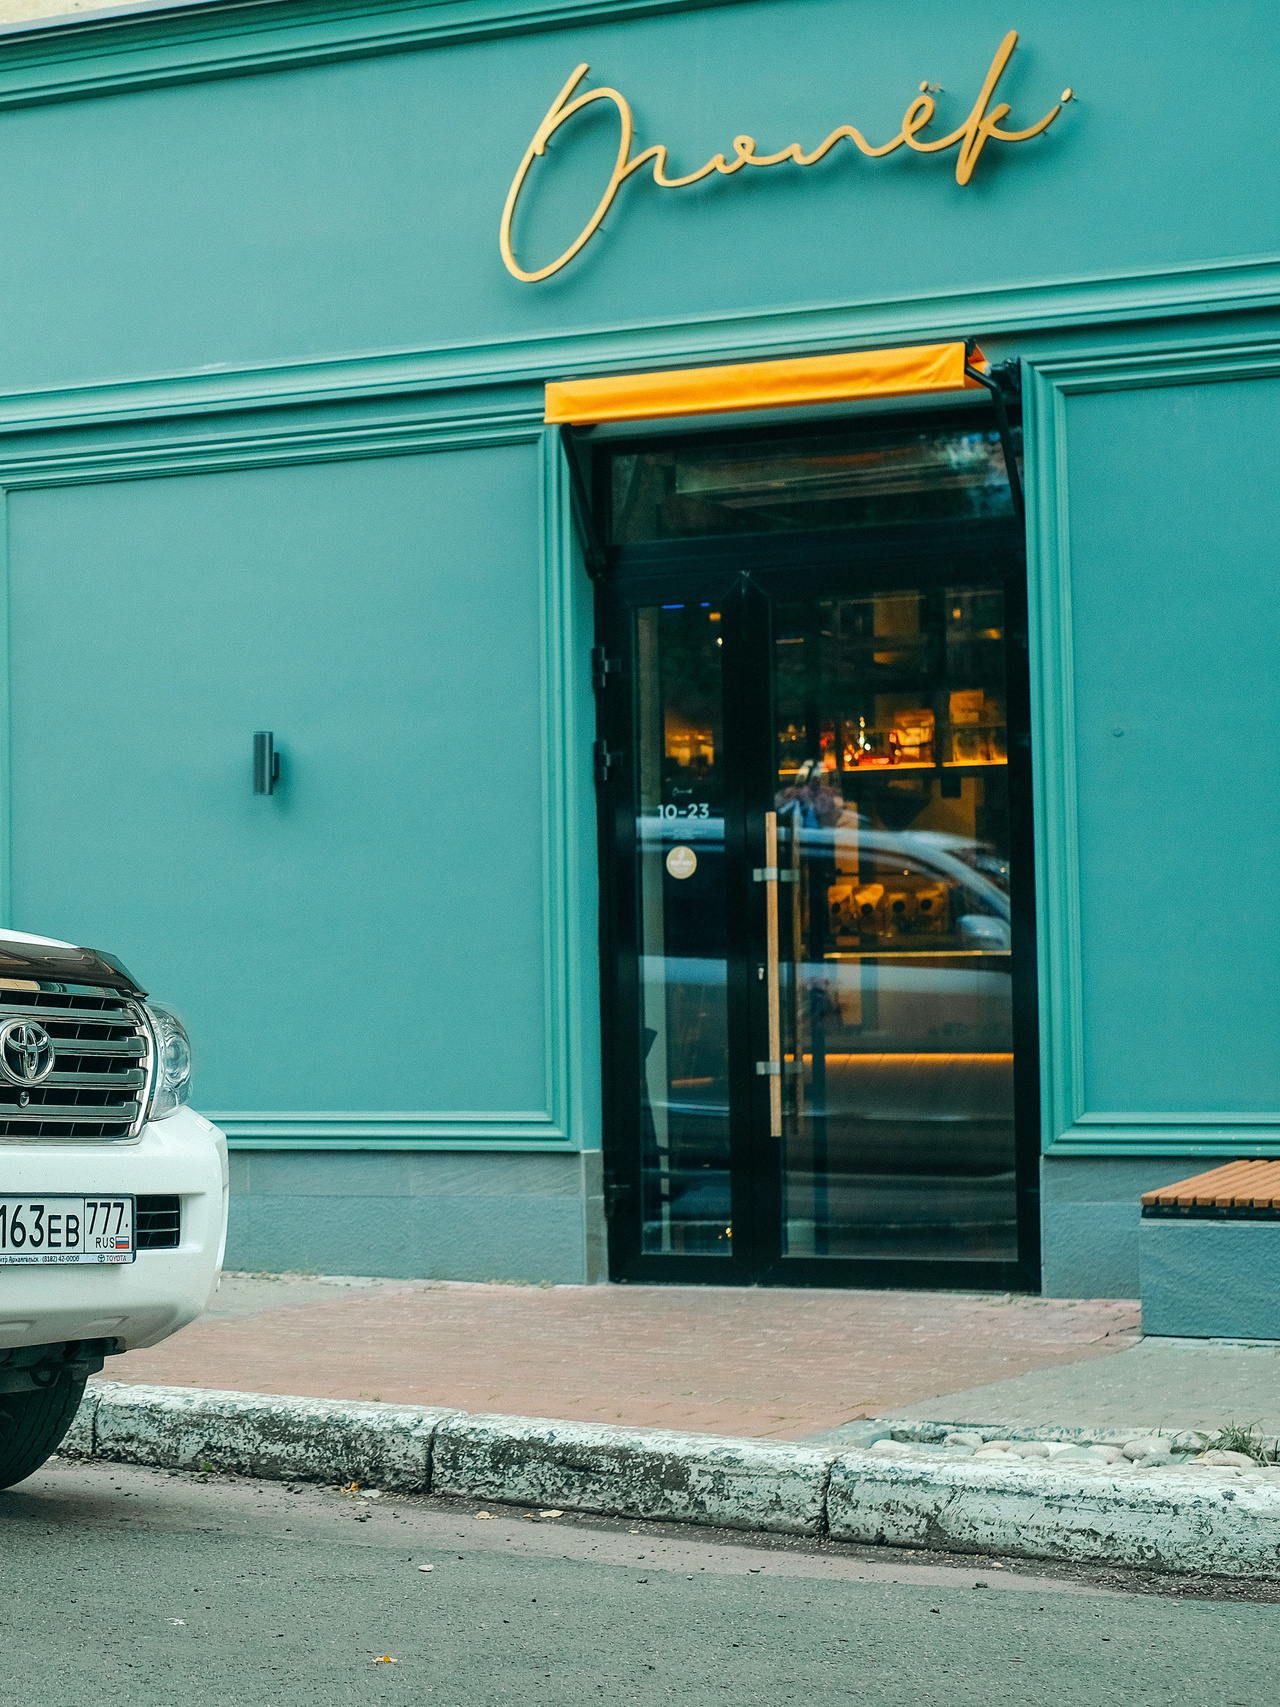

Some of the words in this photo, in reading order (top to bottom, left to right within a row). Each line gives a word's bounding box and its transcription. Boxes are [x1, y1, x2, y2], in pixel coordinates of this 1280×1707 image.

[657, 802, 710, 820] 10-23
[86, 1202, 125, 1235] 777
[95, 1236, 115, 1249] RUS
[106, 1254, 127, 1262] TOYOTA
